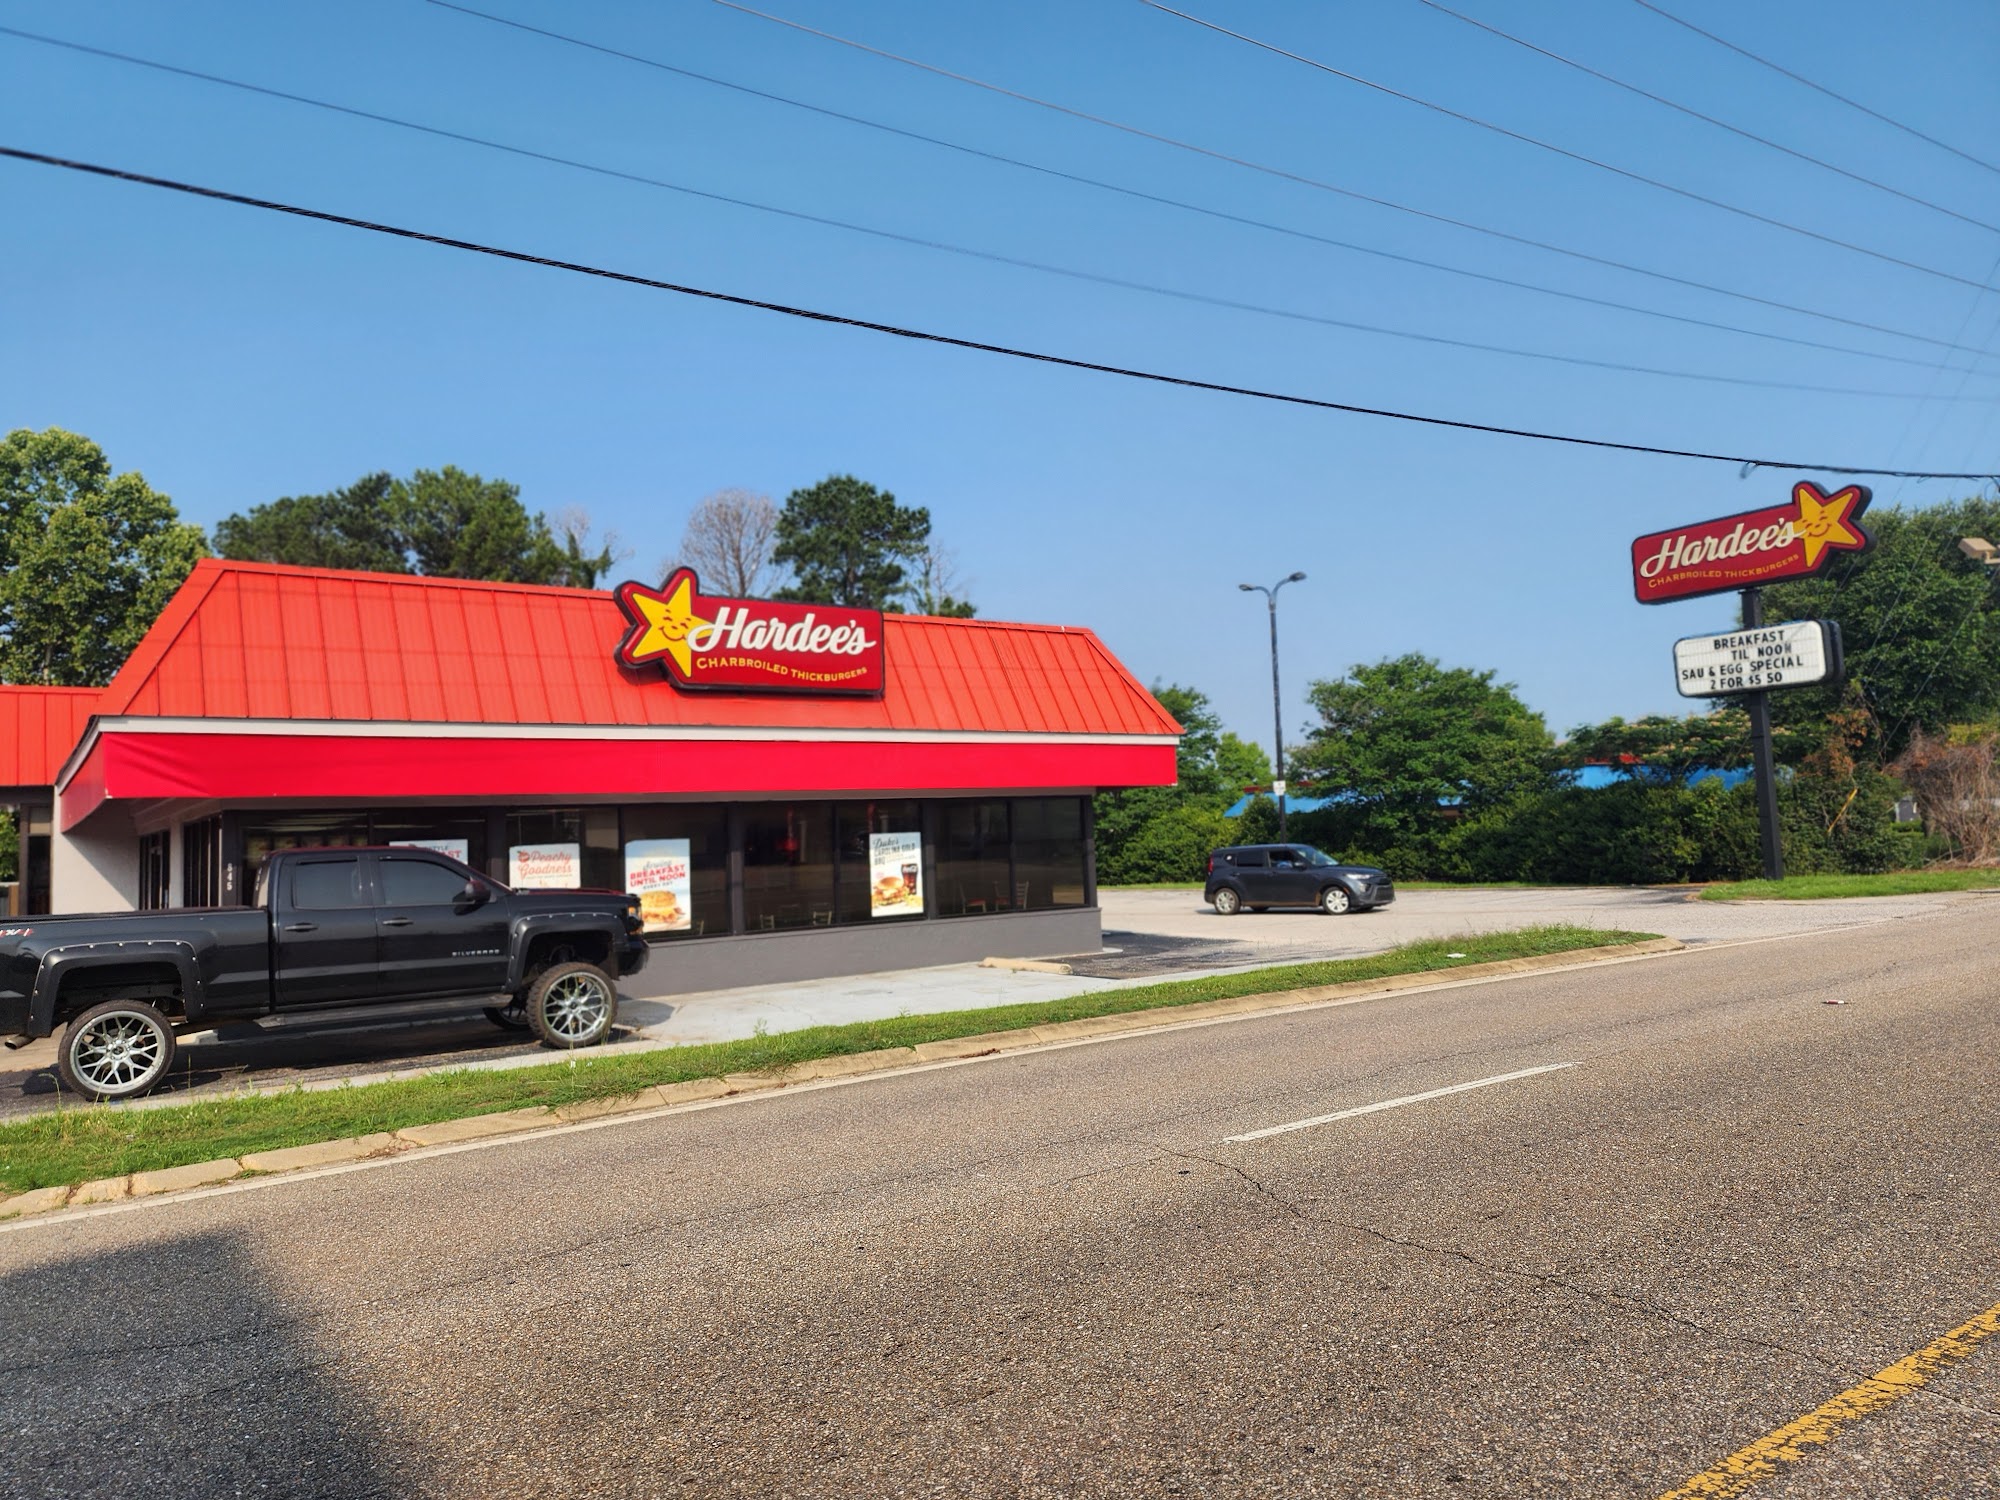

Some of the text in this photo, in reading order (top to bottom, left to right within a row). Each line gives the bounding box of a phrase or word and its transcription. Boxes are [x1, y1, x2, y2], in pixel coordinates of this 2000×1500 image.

[1640, 517, 1807, 578] Hardee's
[1647, 553, 1800, 588] CHARBROILED THICKBURGERS
[687, 607, 877, 655] Hardee's
[1713, 630, 1785, 650] BREAKFAST
[1730, 648, 1750, 661] TIL
[696, 656, 868, 682] CHARBROILED THICKBURGERS
[1681, 654, 1804, 681] SAU & EGG SPECIAL
[1710, 678, 1717, 690] 2
[1720, 676, 1743, 689] FOR
[530, 850, 573, 865] Peachy
[518, 864, 572, 880] Goodness
[629, 864, 686, 880] BREAKFAST
[629, 871, 686, 888] UNTIL NOON
